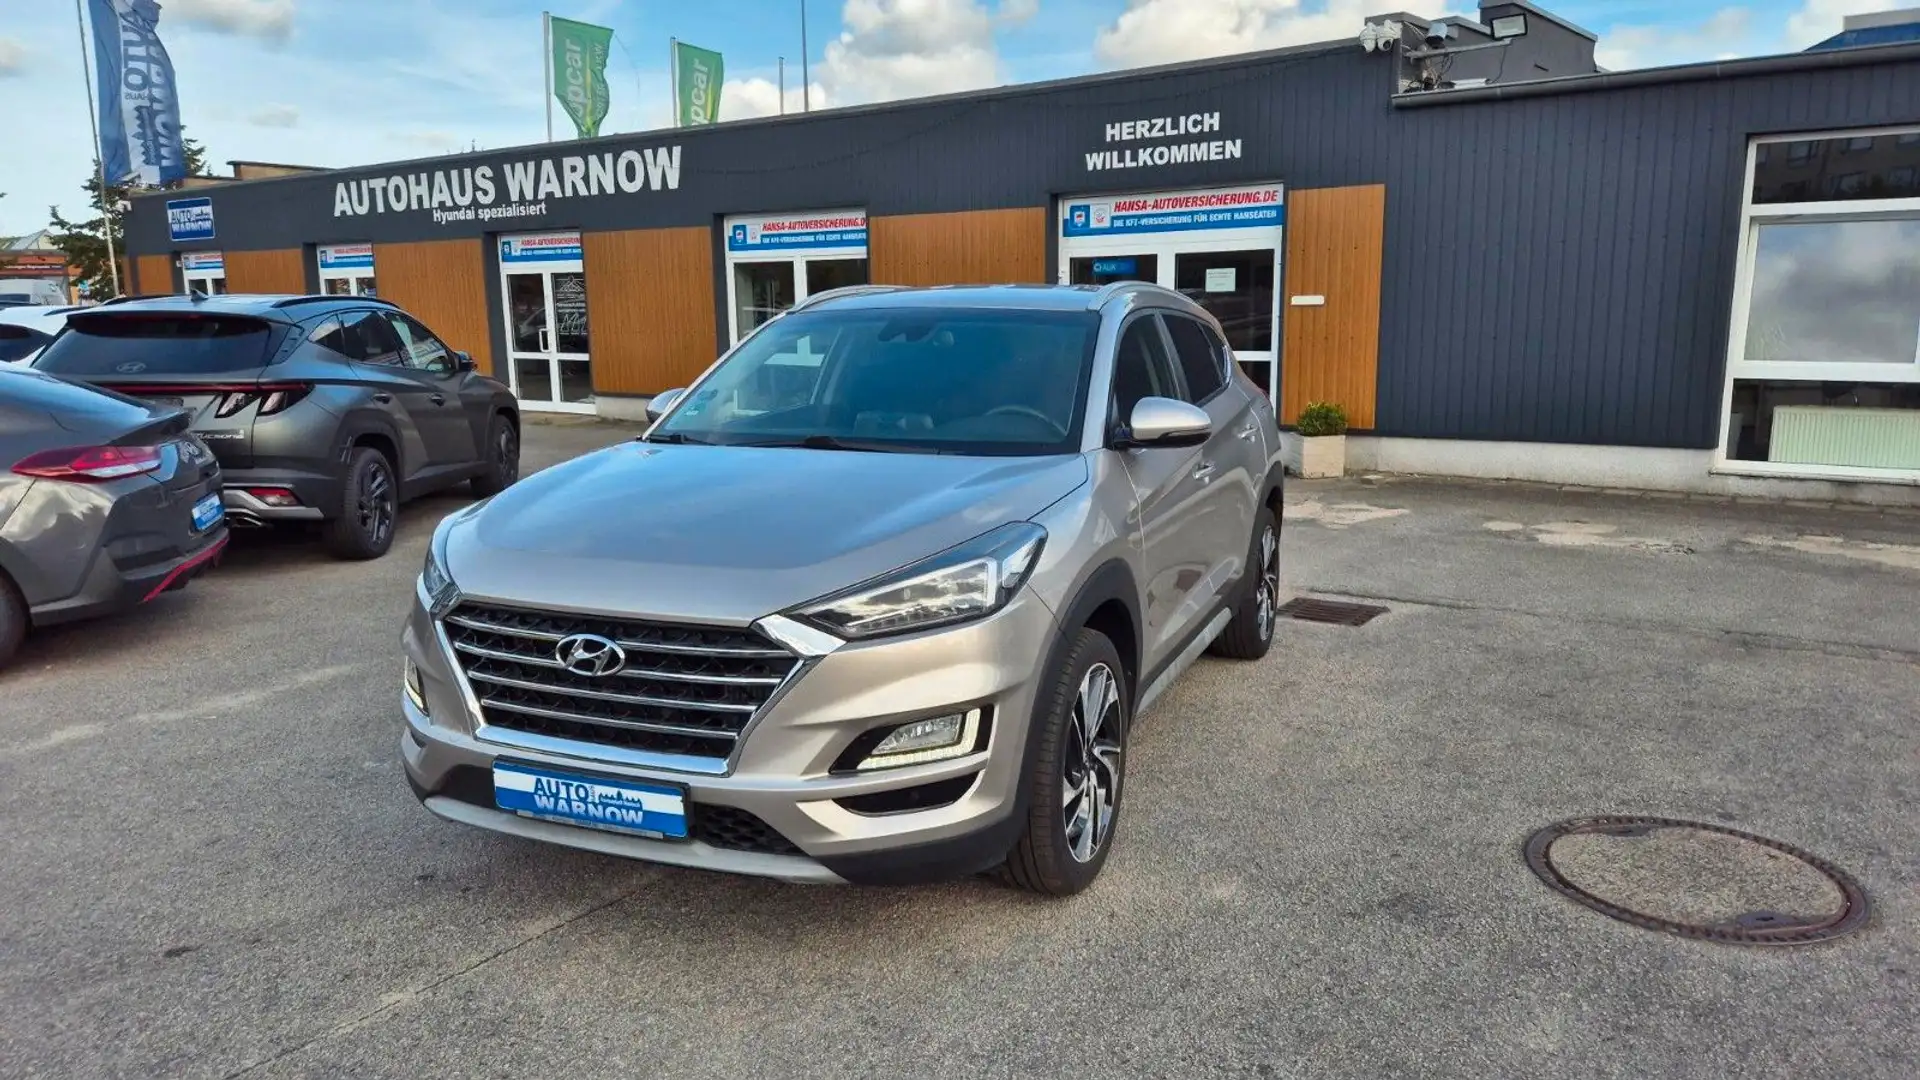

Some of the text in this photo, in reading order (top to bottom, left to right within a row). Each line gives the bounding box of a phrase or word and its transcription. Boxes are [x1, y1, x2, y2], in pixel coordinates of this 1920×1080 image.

[1105, 111, 1220, 142] HERZLICH
[1085, 139, 1242, 171] WILLKOMMEN
[334, 146, 682, 217] AUTOHAUS WARNOW
[433, 201, 547, 225] Hyundai spezialisiert
[1113, 190, 1278, 213] HANSA-AUTOVERSICHERUNG.DE
[534, 777, 589, 801] AUTO
[534, 794, 643, 825] WARNOW
